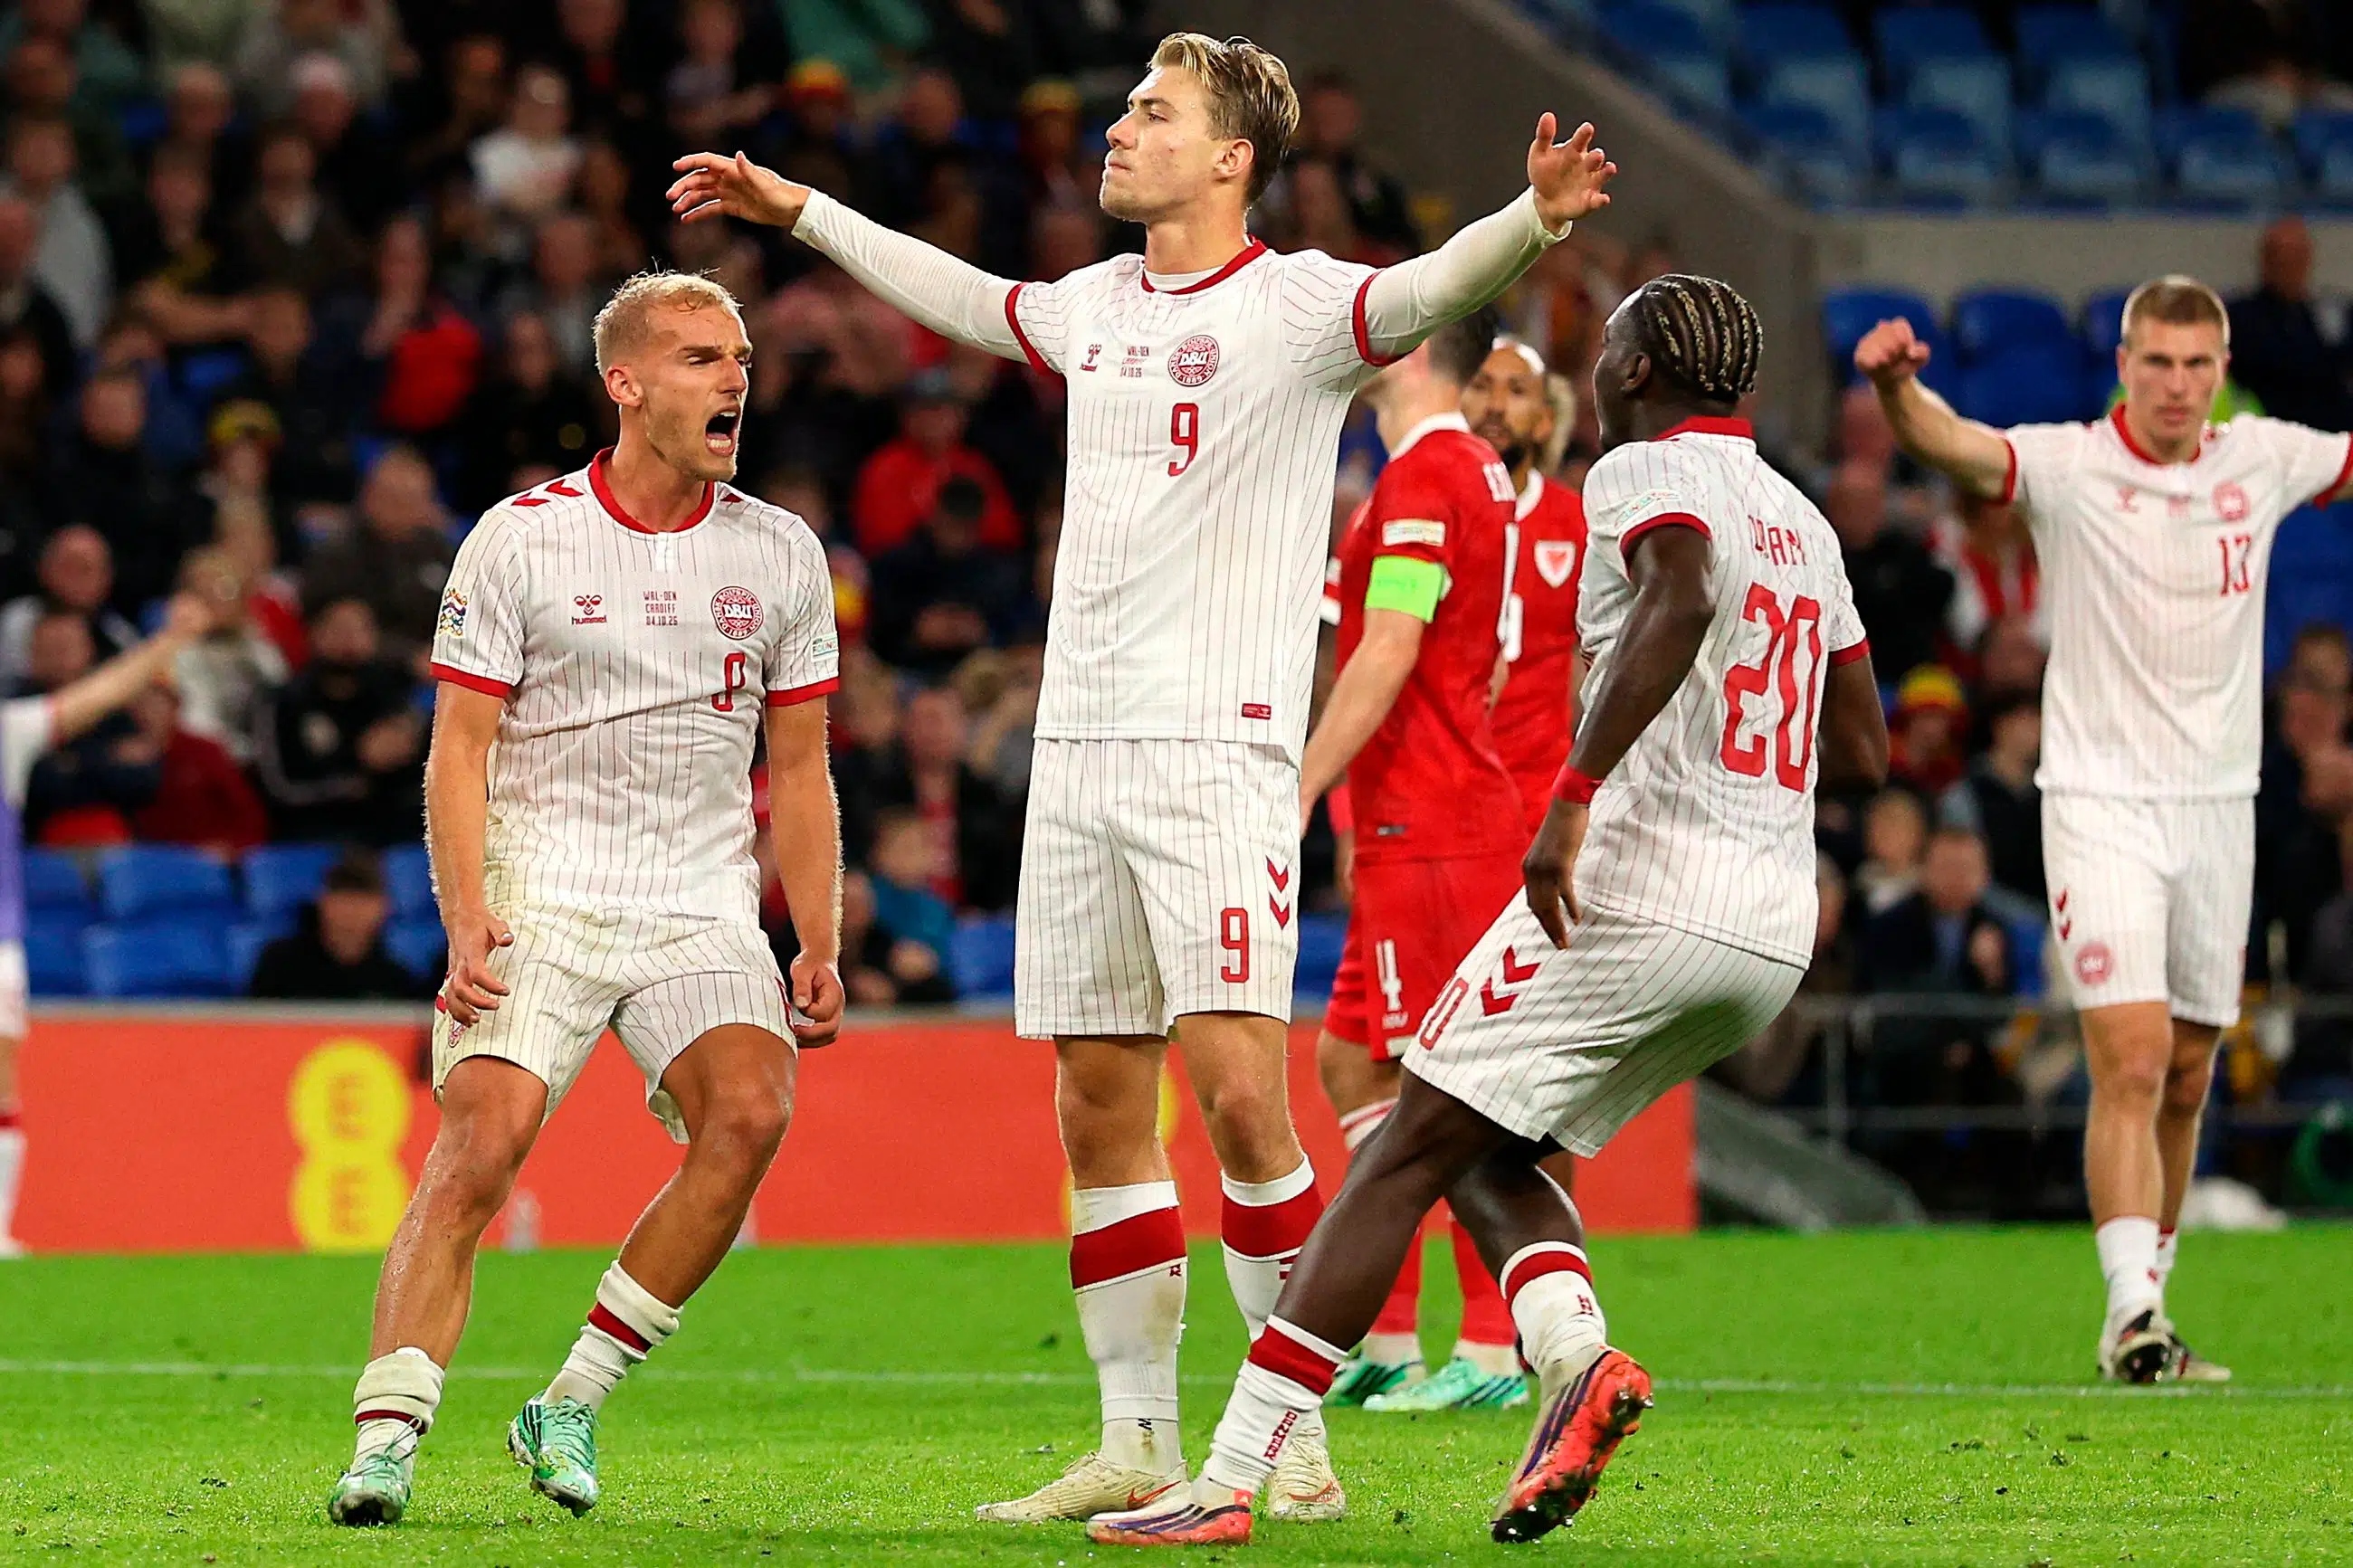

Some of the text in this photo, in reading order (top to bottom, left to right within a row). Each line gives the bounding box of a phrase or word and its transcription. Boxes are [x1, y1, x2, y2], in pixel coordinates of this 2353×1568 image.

[1177, 351, 1209, 366] DBU
[1167, 403, 1199, 477] 9
[644, 603, 676, 614] CARDIFF
[722, 603, 754, 620] DBU
[1720, 581, 1821, 793] 20
[1220, 907, 1250, 984] 9
[1376, 938, 1403, 1012] 4
